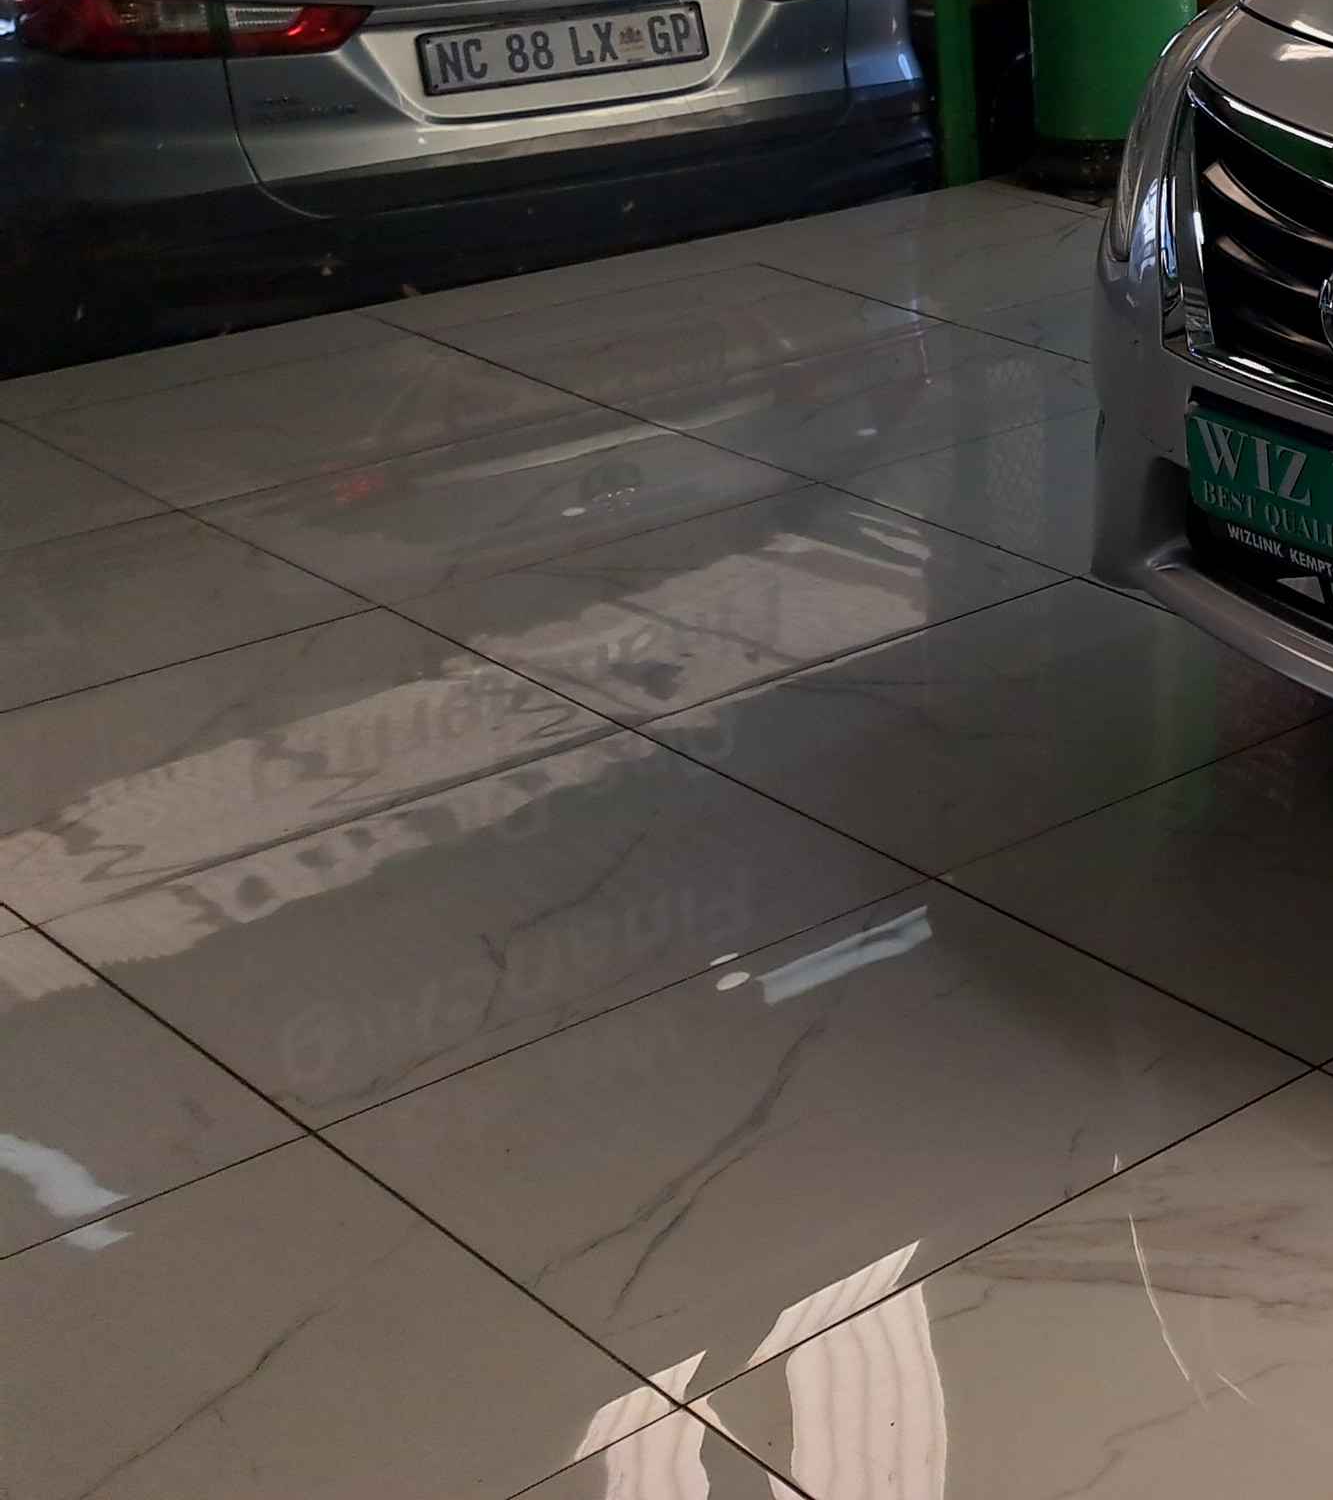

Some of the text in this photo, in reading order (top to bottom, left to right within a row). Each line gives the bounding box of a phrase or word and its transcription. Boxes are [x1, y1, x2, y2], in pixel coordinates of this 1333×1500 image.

[434, 13, 690, 84] NC 88 LX GP
[1192, 415, 1311, 506] WIZ
[1203, 480, 1257, 519] BEST
[1227, 523, 1284, 557] WIZLINK
